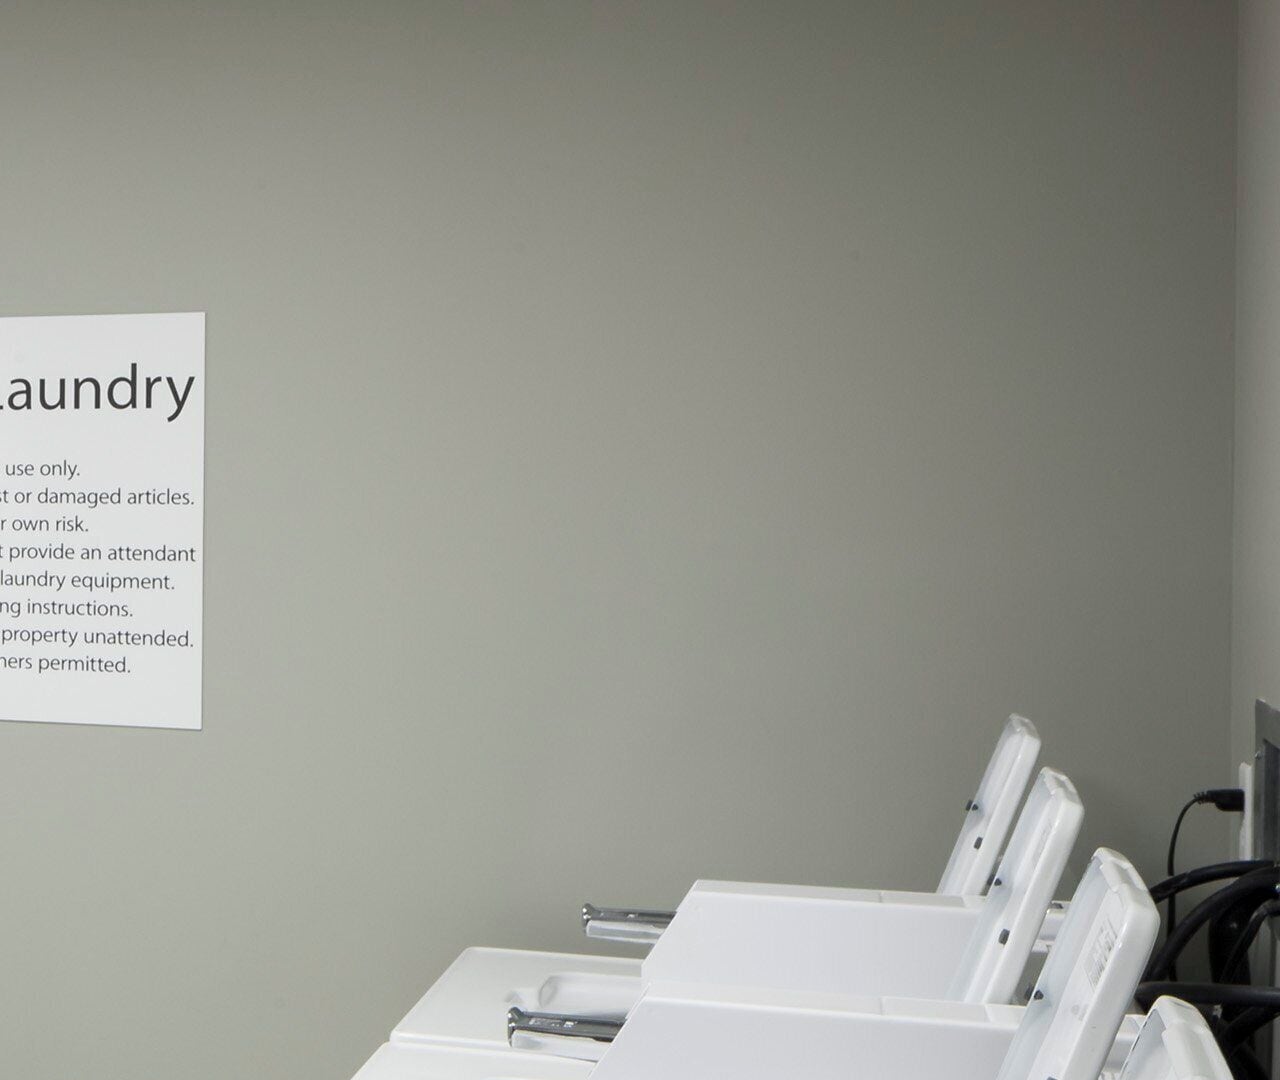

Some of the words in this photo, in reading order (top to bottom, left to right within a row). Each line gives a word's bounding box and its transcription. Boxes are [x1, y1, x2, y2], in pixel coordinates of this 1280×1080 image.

[6, 464, 34, 476] use
[40, 460, 80, 480] only.
[15, 492, 32, 503] or
[38, 488, 120, 508] damaged
[128, 488, 194, 505] articles.
[12, 519, 49, 531] own
[56, 515, 88, 532] risk.
[10, 543, 75, 562] provide
[81, 548, 101, 560] an
[108, 545, 195, 562] attendant
[1, 570, 65, 591] laundry
[71, 573, 174, 592] equipment.
[28, 599, 132, 617] instructions.
[2, 629, 78, 647] property
[84, 630, 193, 647] unattended.
[39, 656, 130, 673] permitted.
